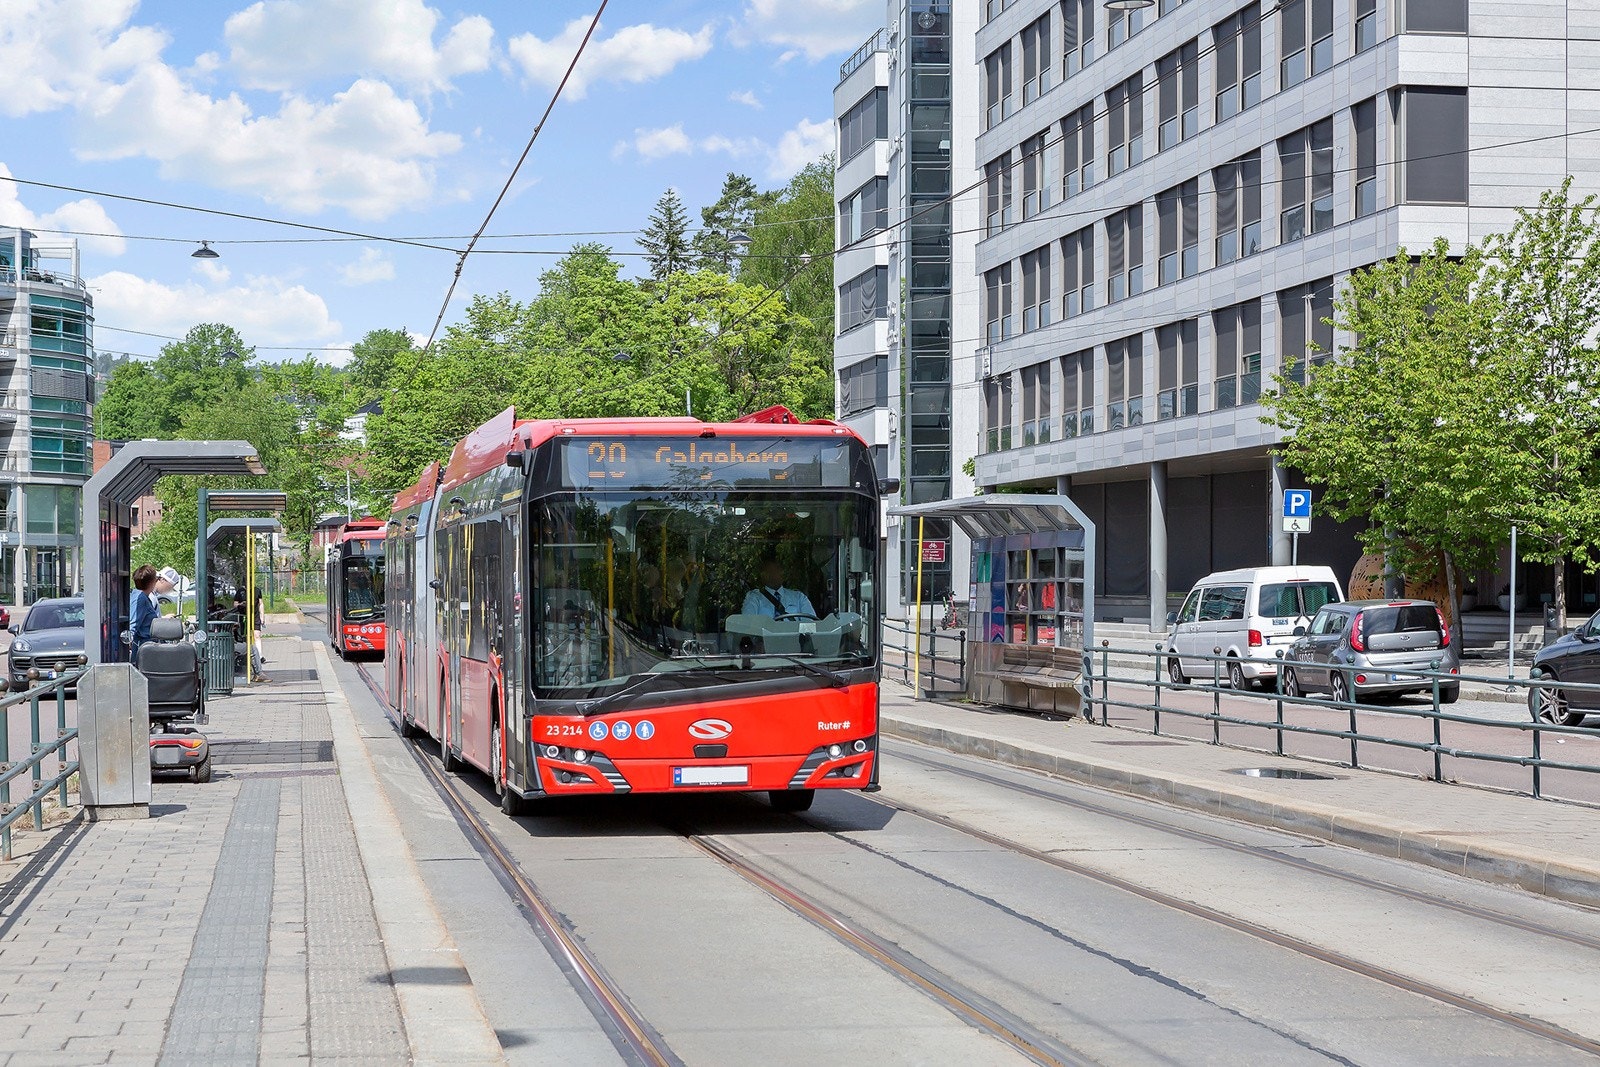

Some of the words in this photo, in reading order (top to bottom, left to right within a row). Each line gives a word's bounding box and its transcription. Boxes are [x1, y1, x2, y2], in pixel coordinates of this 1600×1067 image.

[588, 442, 627, 478] 20
[1290, 493, 1306, 515] P
[546, 725, 560, 736] 23
[562, 725, 583, 736] 214
[817, 721, 851, 731] Ruter#
